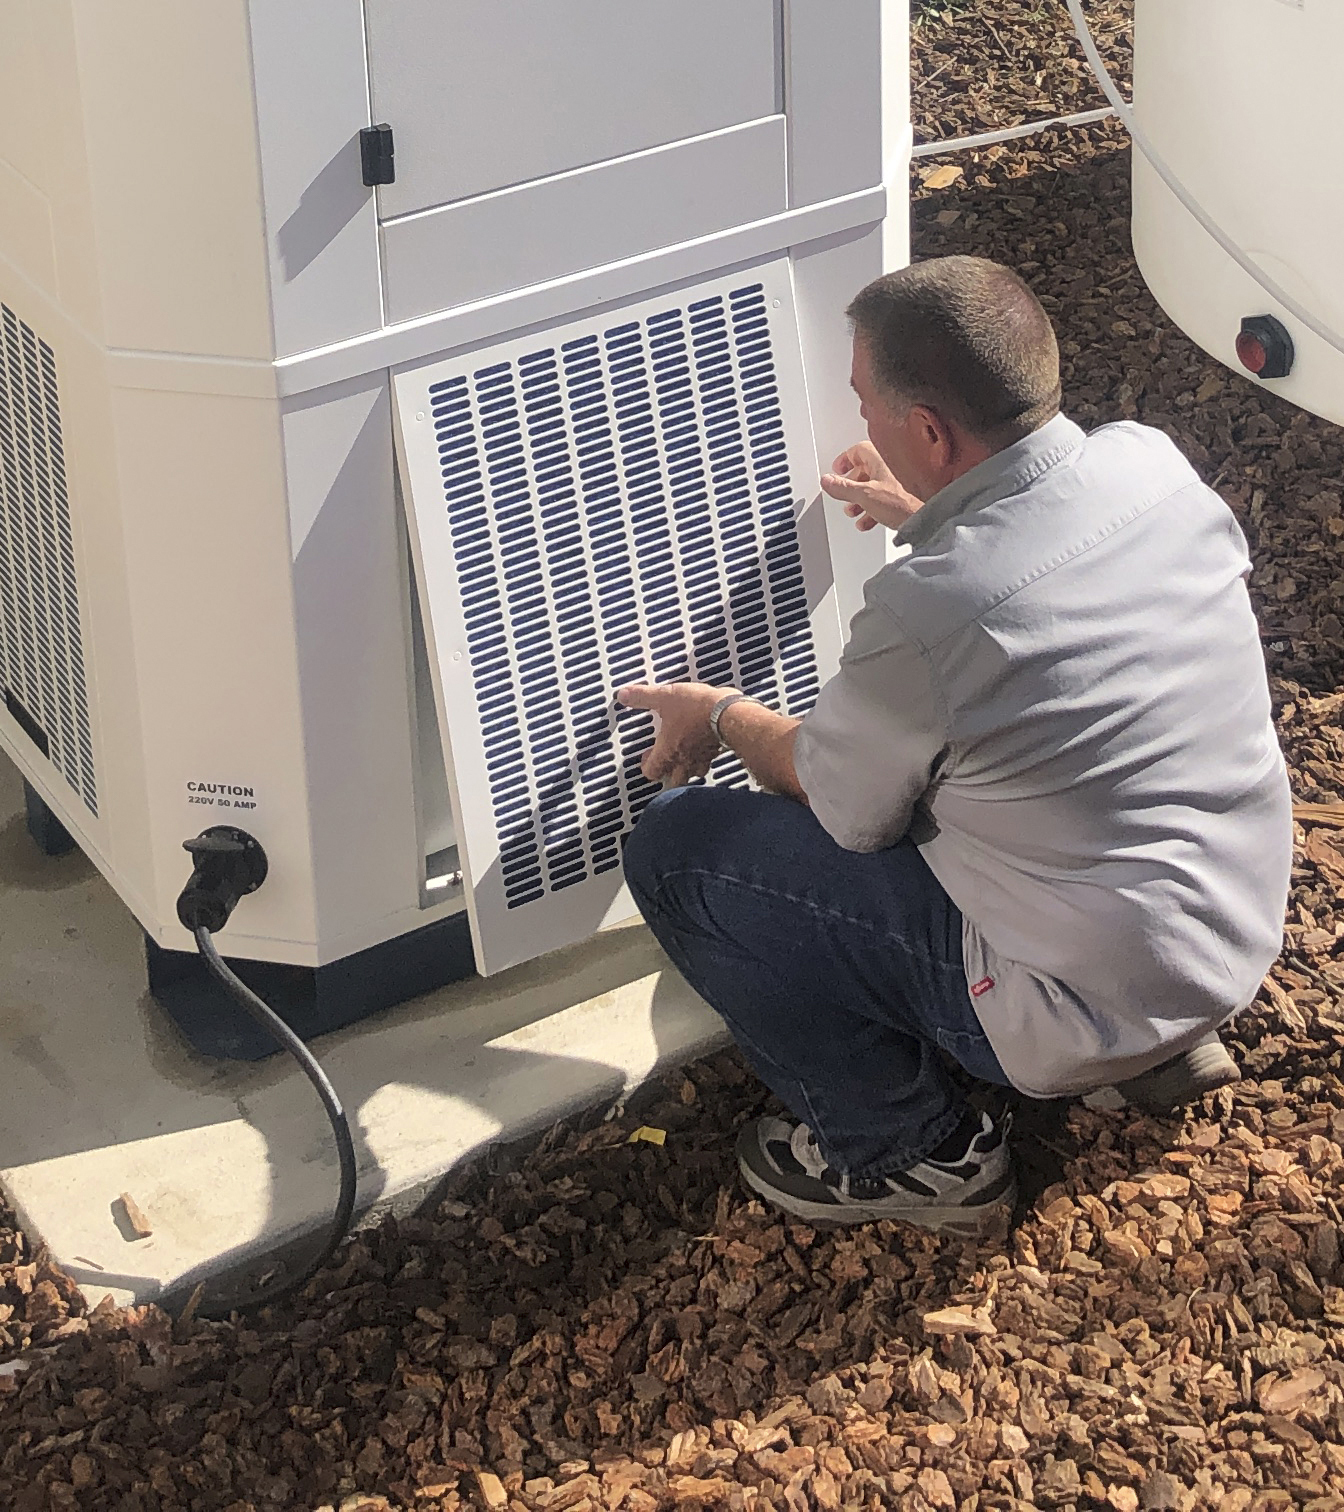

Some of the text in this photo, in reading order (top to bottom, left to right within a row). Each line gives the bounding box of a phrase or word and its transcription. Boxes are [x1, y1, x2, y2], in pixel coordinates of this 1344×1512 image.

[187, 781, 254, 797] CAUTION
[188, 795, 257, 809] 220V 50 AMP
